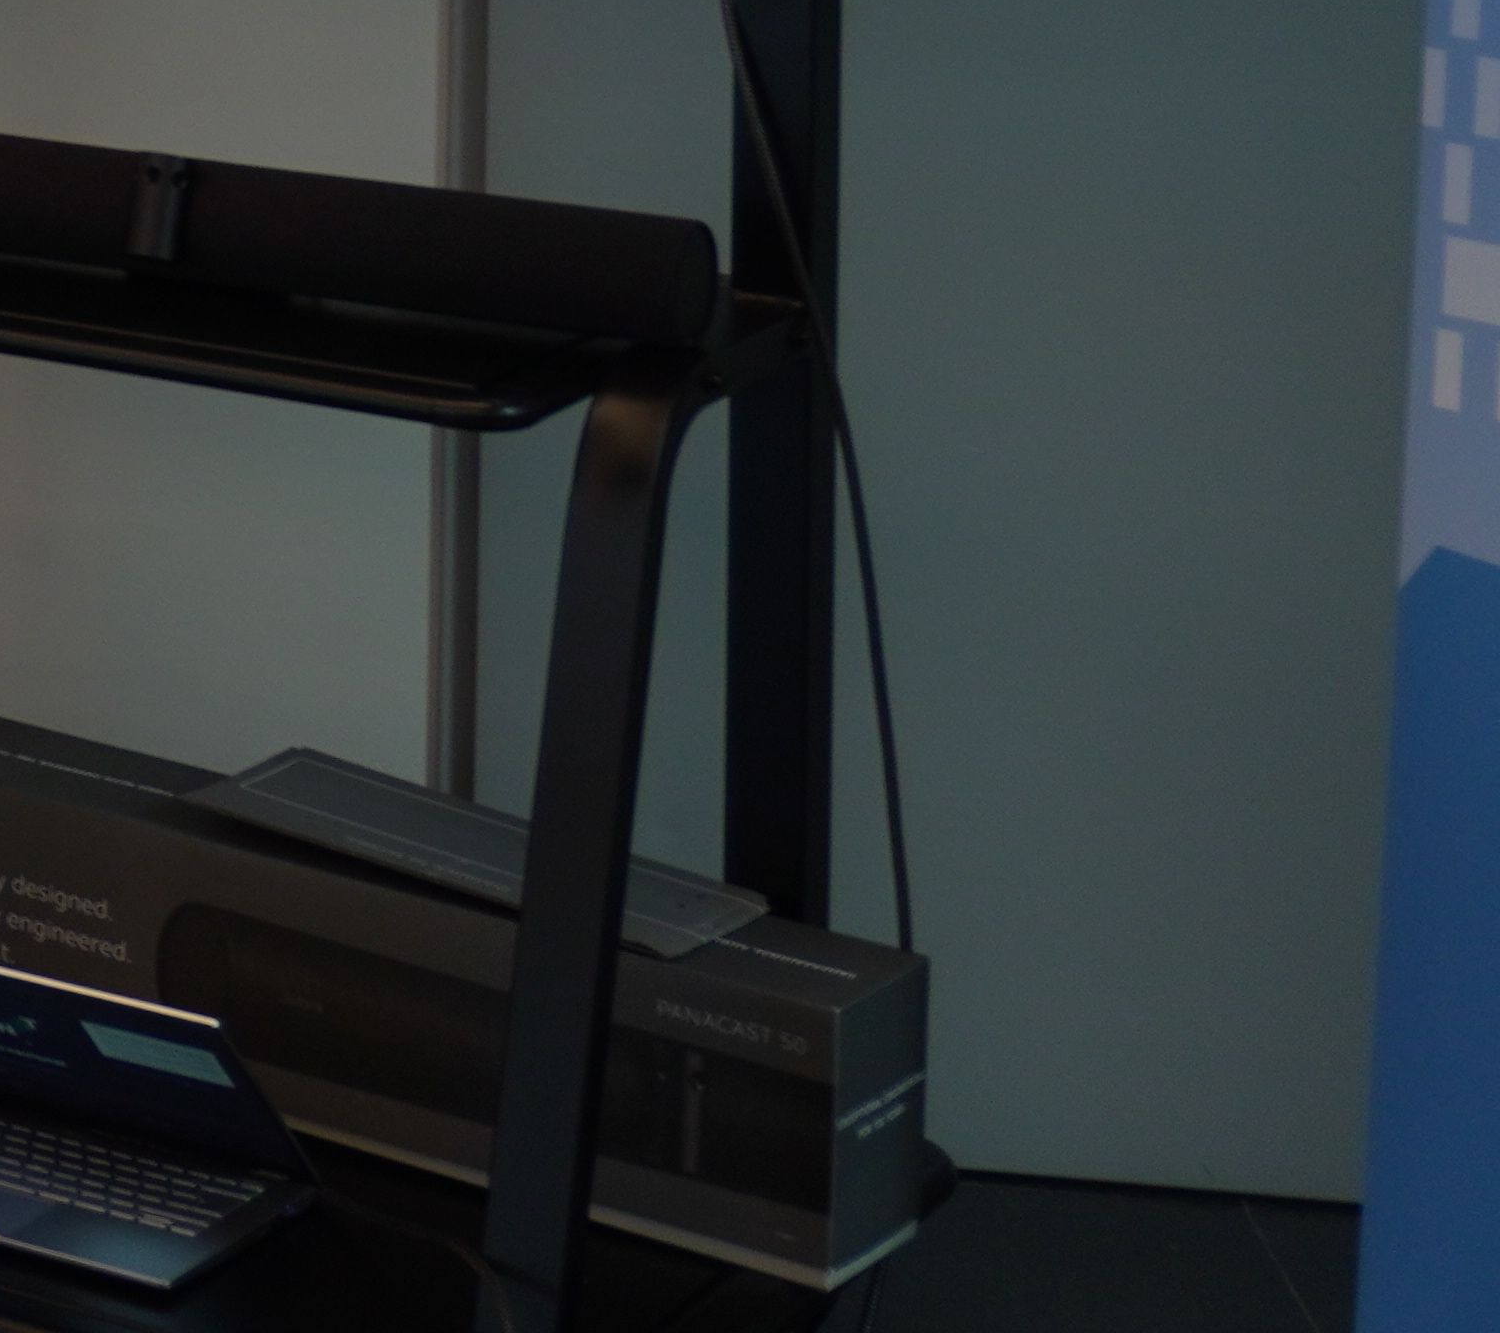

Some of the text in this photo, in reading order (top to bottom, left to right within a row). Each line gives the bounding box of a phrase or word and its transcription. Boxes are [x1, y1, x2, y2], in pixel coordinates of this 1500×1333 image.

[11, 874, 113, 921] designed.
[5, 911, 132, 963] engineered.
[655, 997, 771, 1044] PANACAST
